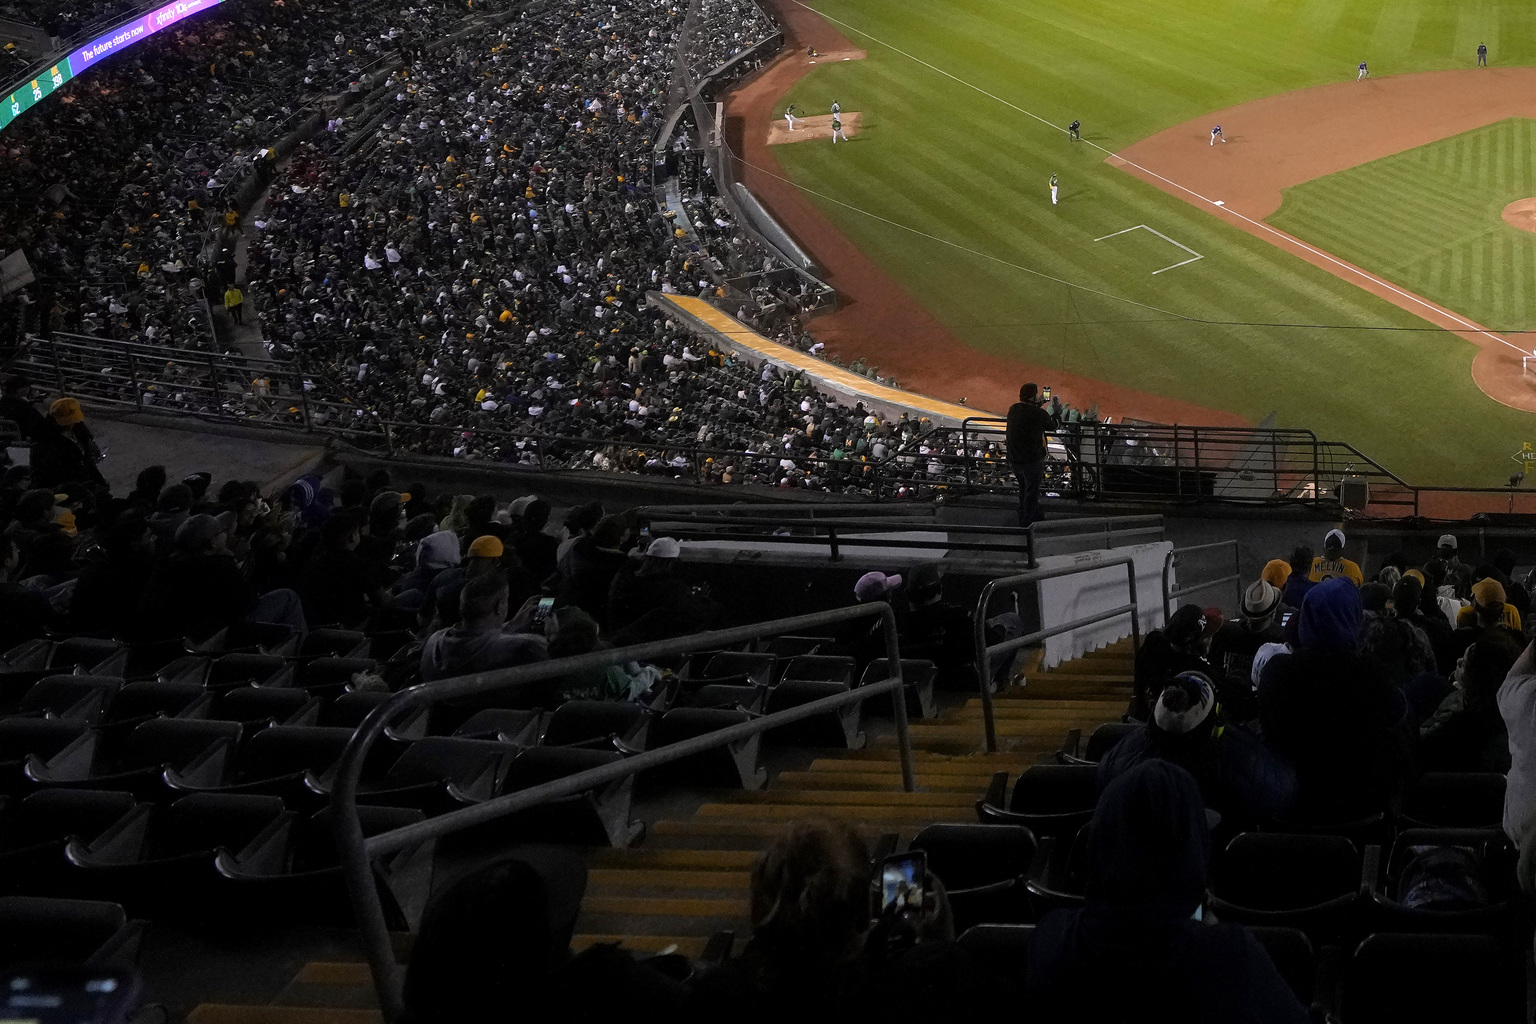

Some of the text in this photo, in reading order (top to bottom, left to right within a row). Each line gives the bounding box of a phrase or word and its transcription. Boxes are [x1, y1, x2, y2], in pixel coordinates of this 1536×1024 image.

[156, 8, 175, 26] xfinity
[82, 25, 144, 62] The future starts now
[33, 86, 42, 101] 25
[11, 102, 20, 117] 62
[1314, 560, 1346, 574] MELVIN
